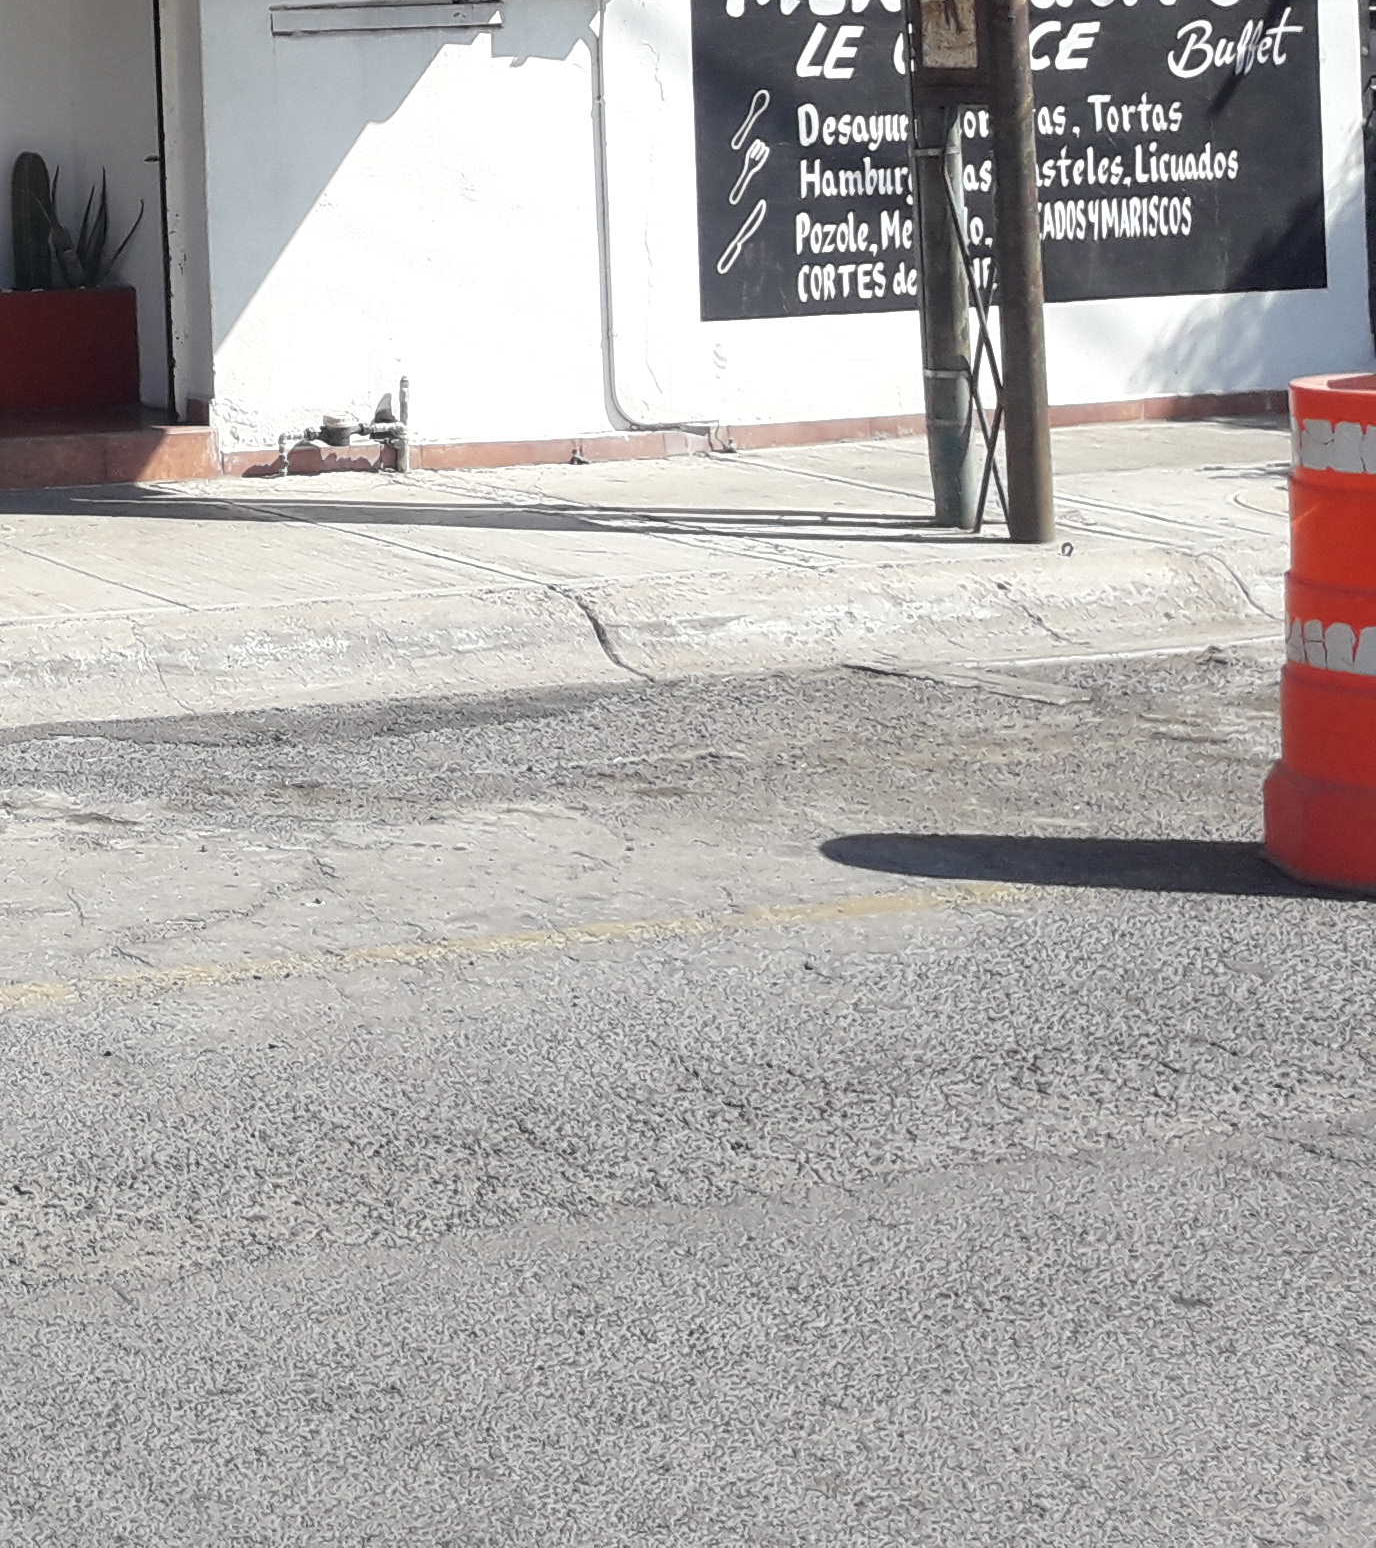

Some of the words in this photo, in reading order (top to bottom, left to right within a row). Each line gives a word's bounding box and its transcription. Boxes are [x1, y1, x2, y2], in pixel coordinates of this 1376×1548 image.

[796, 21, 866, 79] LE
[1168, 8, 1304, 79] Buffet
[1086, 91, 1184, 134] Tortas
[1134, 140, 1240, 183] Licuados
[797, 261, 886, 303] CORTES
[892, 262, 918, 296] de
